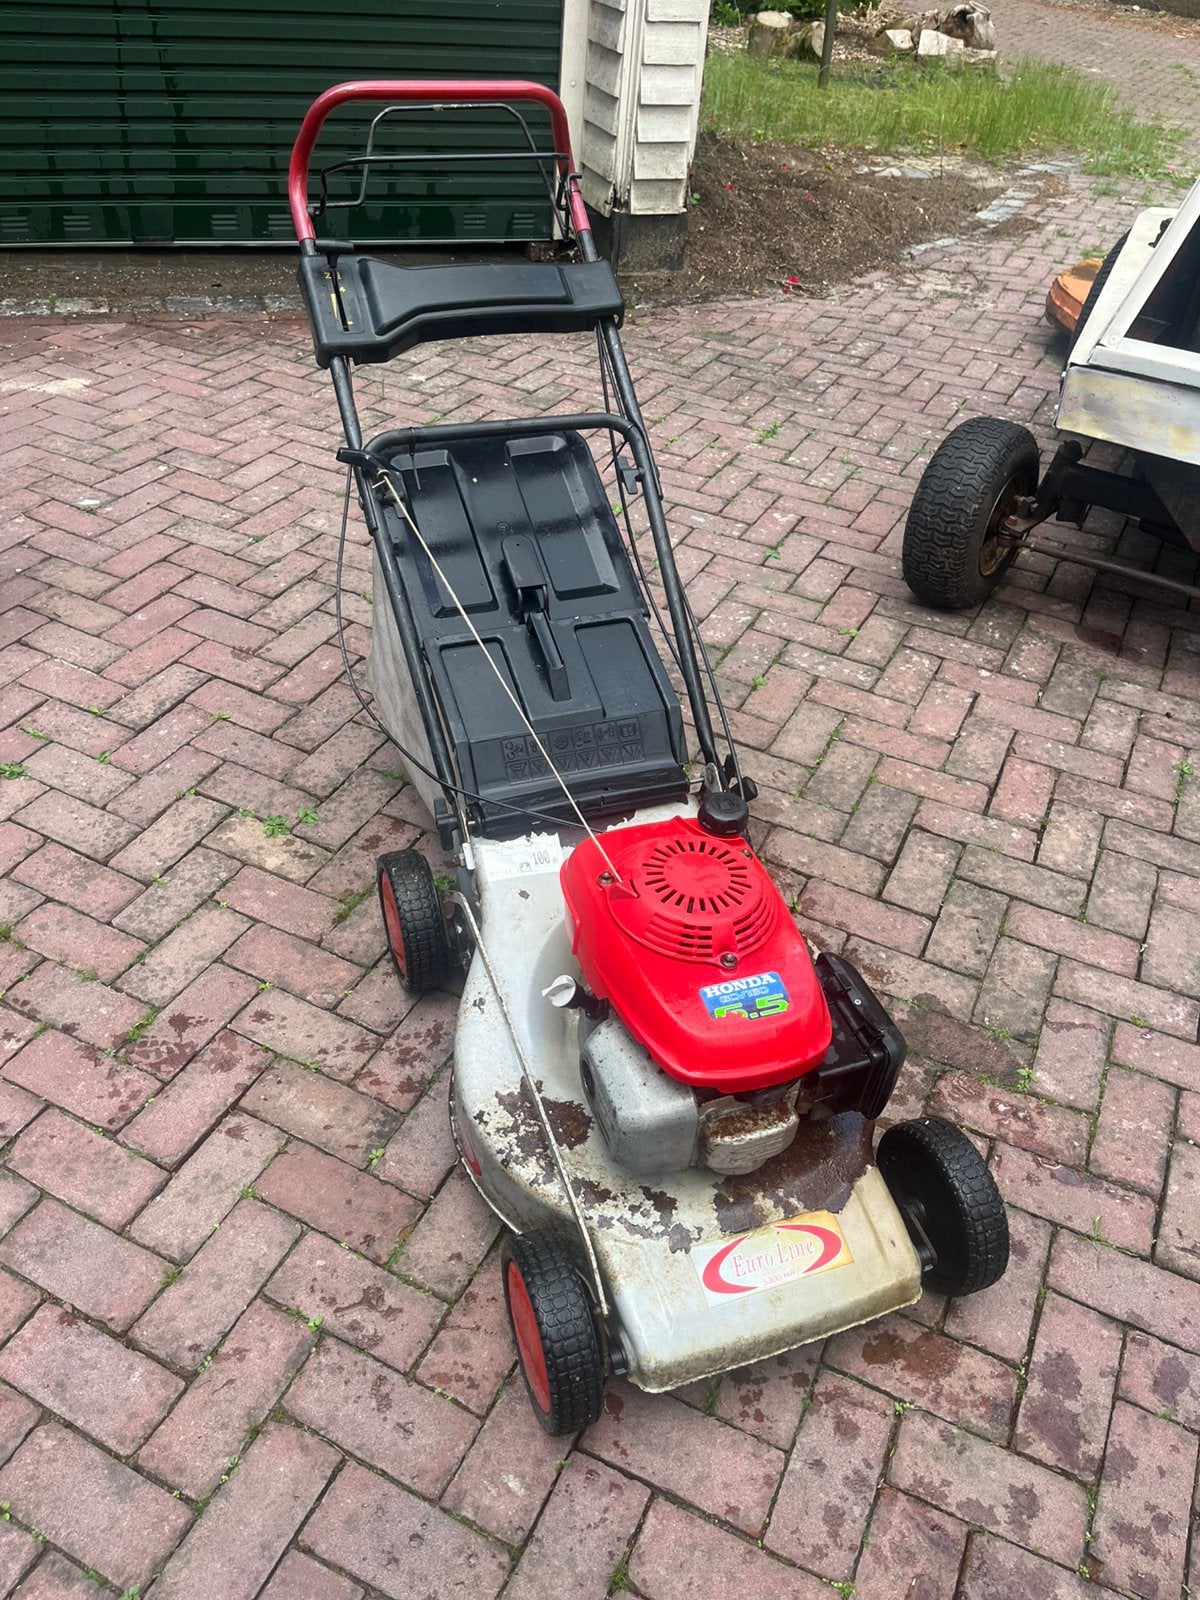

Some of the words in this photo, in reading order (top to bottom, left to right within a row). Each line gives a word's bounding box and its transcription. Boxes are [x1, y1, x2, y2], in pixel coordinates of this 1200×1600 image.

[532, 849, 551, 866] 100
[702, 974, 777, 998] HONDA
[732, 1250, 774, 1278] Euro
[776, 1238, 815, 1264] Line
